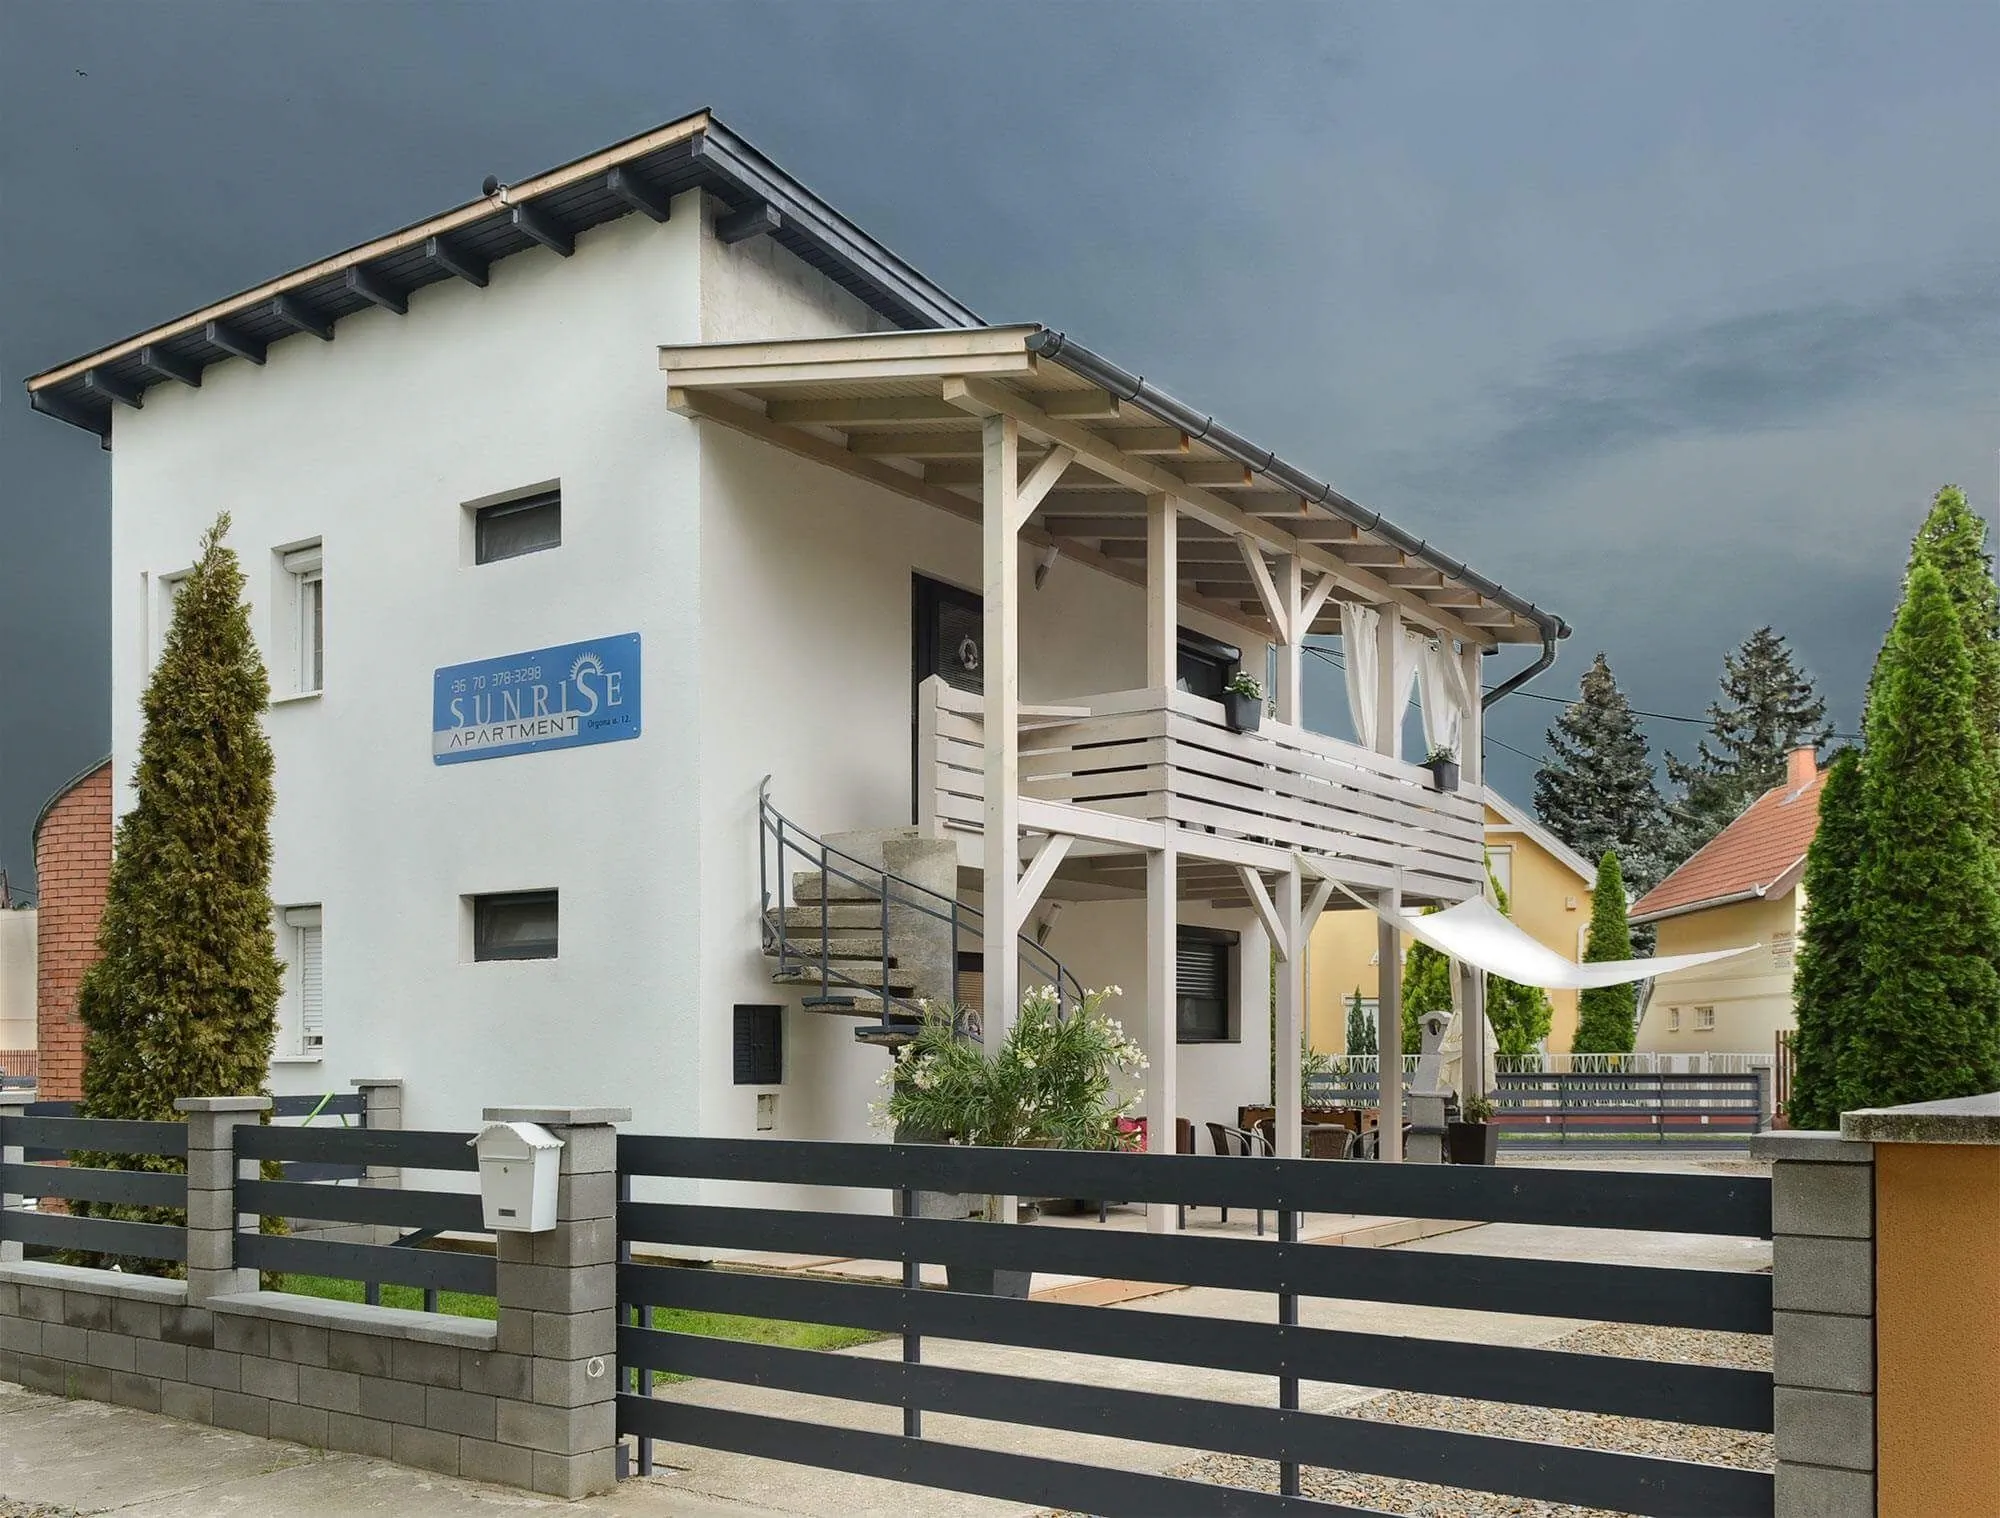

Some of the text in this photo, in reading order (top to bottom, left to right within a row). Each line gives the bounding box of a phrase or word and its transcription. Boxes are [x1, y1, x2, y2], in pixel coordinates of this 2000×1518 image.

[472, 675, 486, 690] 70
[492, 666, 542, 687] 378-3298
[450, 668, 622, 730] SUNRISE
[450, 715, 580, 748] APARTMENT
